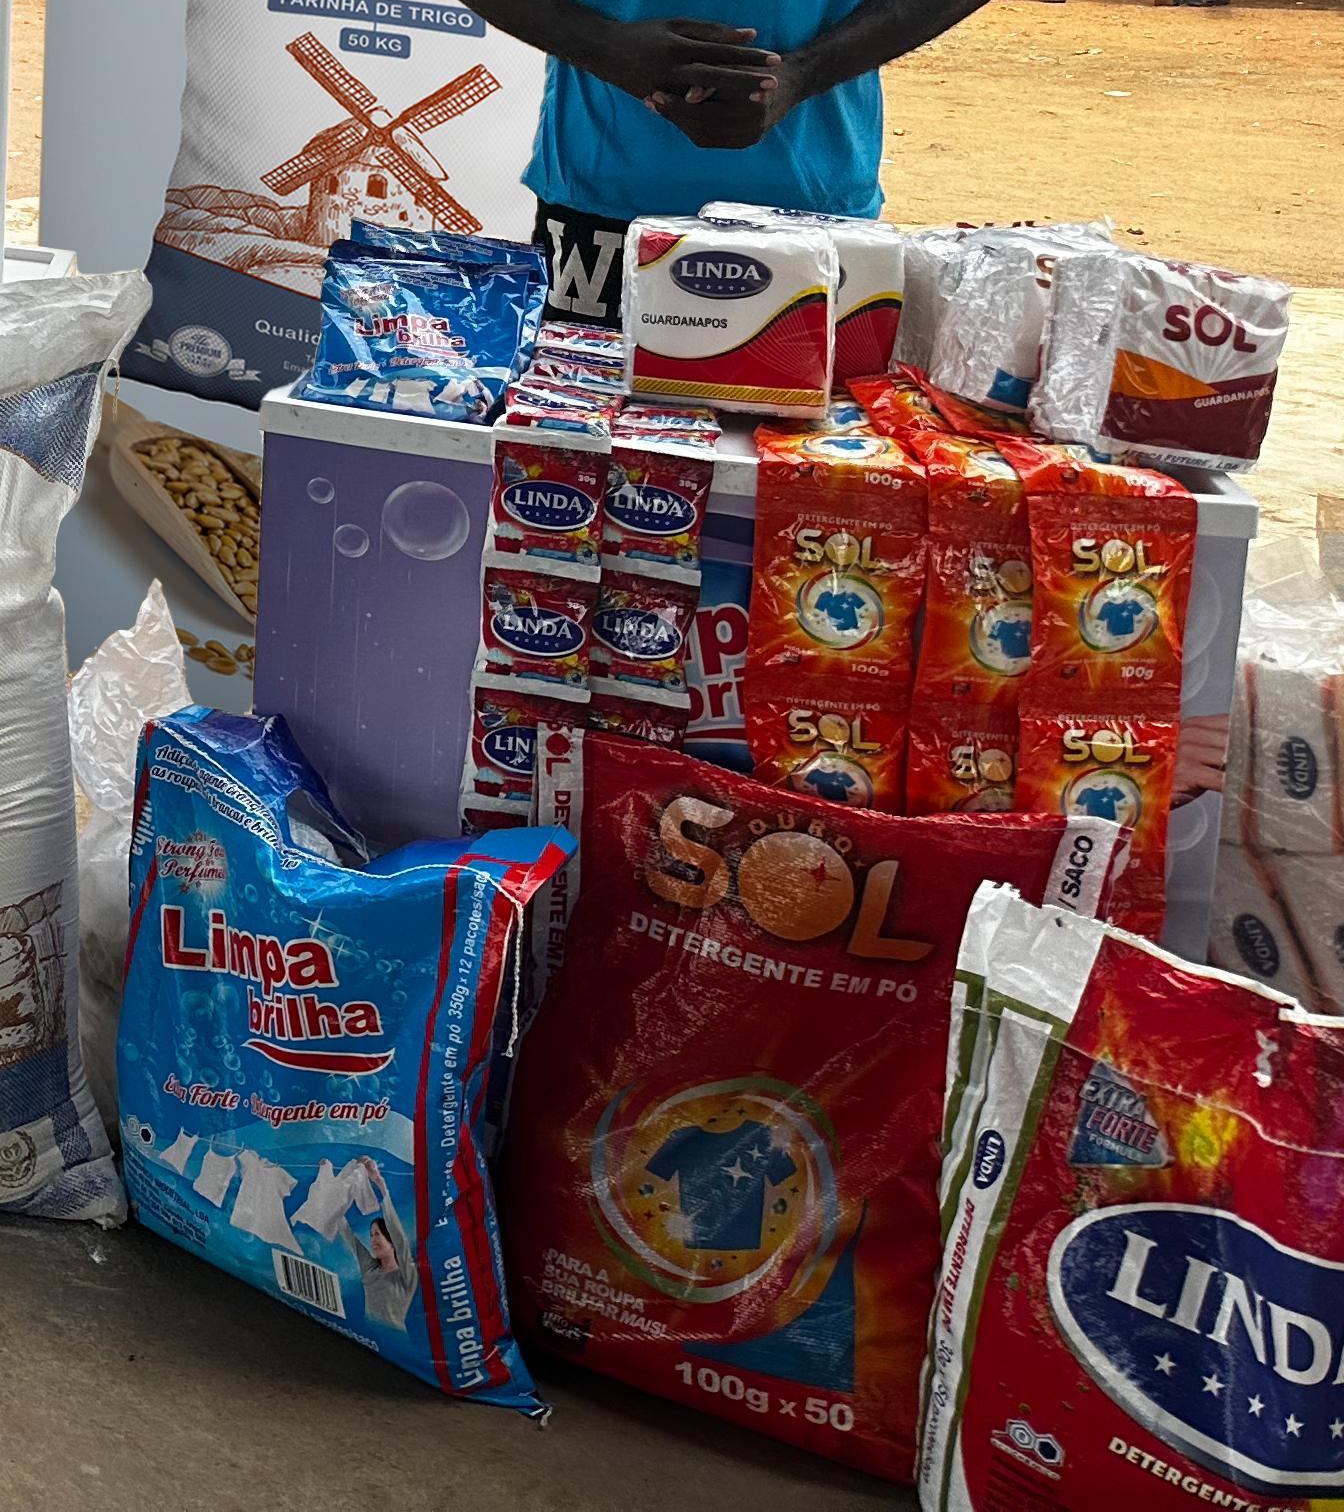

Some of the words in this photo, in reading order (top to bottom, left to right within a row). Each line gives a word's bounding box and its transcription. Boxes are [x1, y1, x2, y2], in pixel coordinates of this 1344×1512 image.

[375, 1, 403, 19] DE
[408, 6, 474, 29] TRIGO
[347, 32, 369, 49] 50
[373, 36, 402, 53] KG
[680, 257, 762, 283] LINDA
[354, 314, 450, 336] Limpa
[641, 312, 728, 331] GUARDANAPOS
[1162, 302, 1257, 354] SOL
[863, 471, 903, 491] 100g
[514, 489, 583, 512] LINDA
[613, 494, 685, 518] LINDA
[797, 513, 862, 529] DETERGENTE
[795, 528, 890, 571] SOL
[1070, 538, 1167, 576] SOL
[502, 614, 574, 640] LINDA
[850, 662, 889, 677] 100g
[1119, 665, 1154, 682] 100g
[789, 710, 882, 753] SOL
[1061, 728, 1152, 765] SOL
[645, 795, 936, 964] SOL
[1061, 835, 1095, 898] SACO
[160, 904, 341, 990] Limpa
[461, 957, 474, 973] 12
[629, 911, 825, 990] DETERGENTE
[829, 972, 873, 995] EM
[877, 974, 920, 1004] PÓ
[247, 987, 384, 1042] brilha
[445, 1044, 458, 1068] em
[326, 1100, 358, 1120] em
[360, 1096, 389, 1123] pó
[439, 1070, 459, 1150] Detergente
[1084, 1106, 1160, 1156] FORTE
[974, 1135, 1003, 1185] LINDA
[545, 1248, 593, 1275] PARA
[441, 1255, 463, 1321] brilha
[541, 1279, 617, 1320] BRILHAR
[543, 1265, 581, 1286] SUA
[584, 1279, 645, 1313] ROUPA
[675, 1360, 770, 1413] 100g
[779, 1398, 798, 1418] x
[804, 1397, 855, 1432] 50
